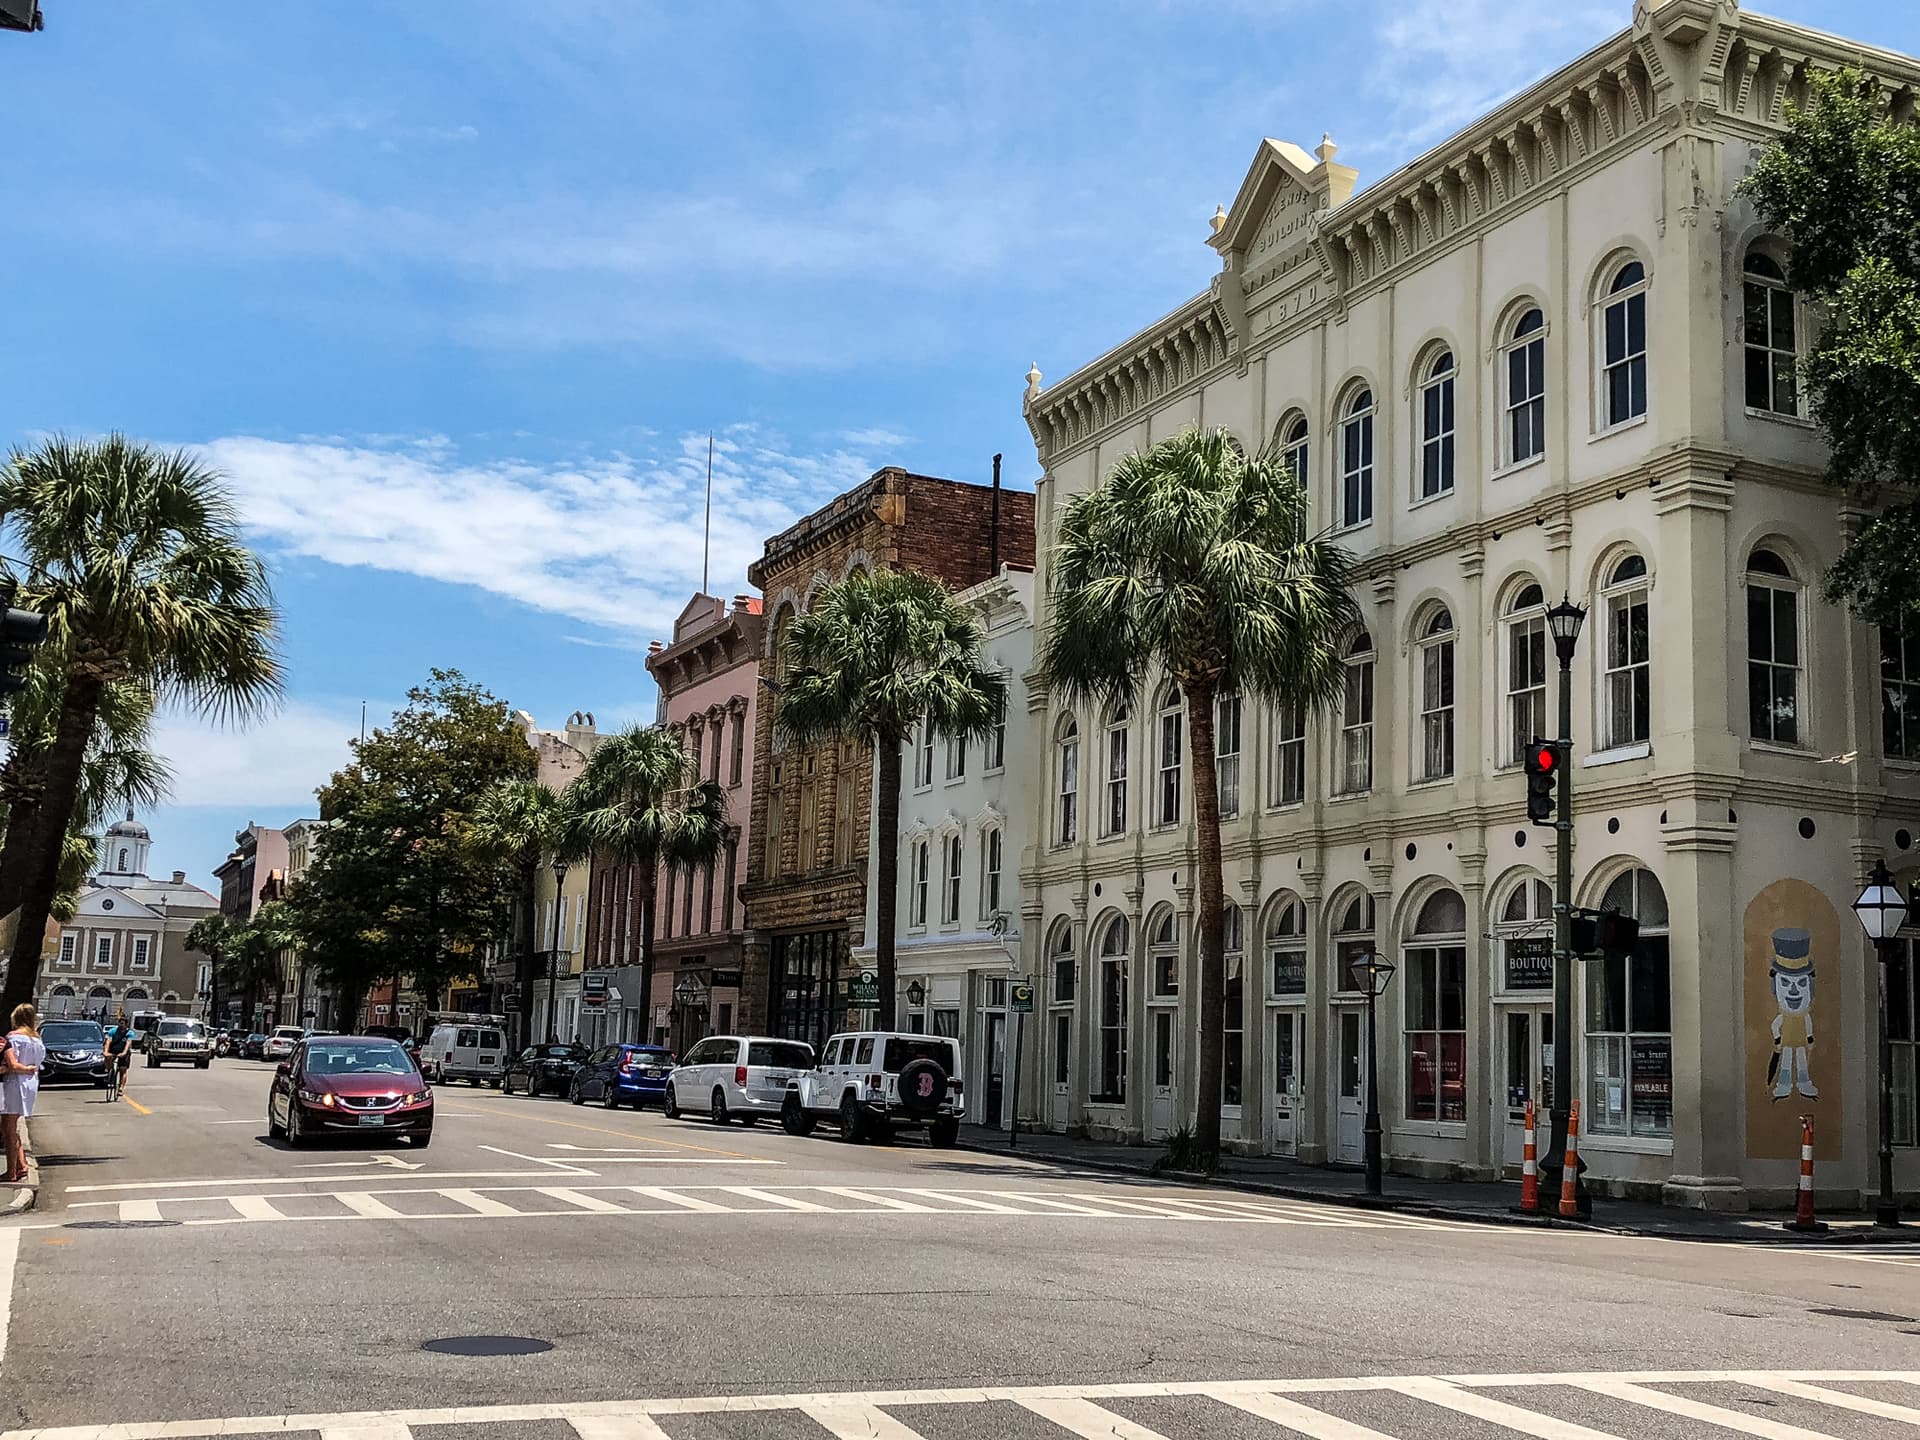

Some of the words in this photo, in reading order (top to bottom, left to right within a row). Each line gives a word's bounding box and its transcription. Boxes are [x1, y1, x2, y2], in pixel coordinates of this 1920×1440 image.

[1264, 285, 1317, 330] 1870
[1527, 944, 1542, 952] THE
[1634, 1084, 1669, 1093] AVAILABLE
